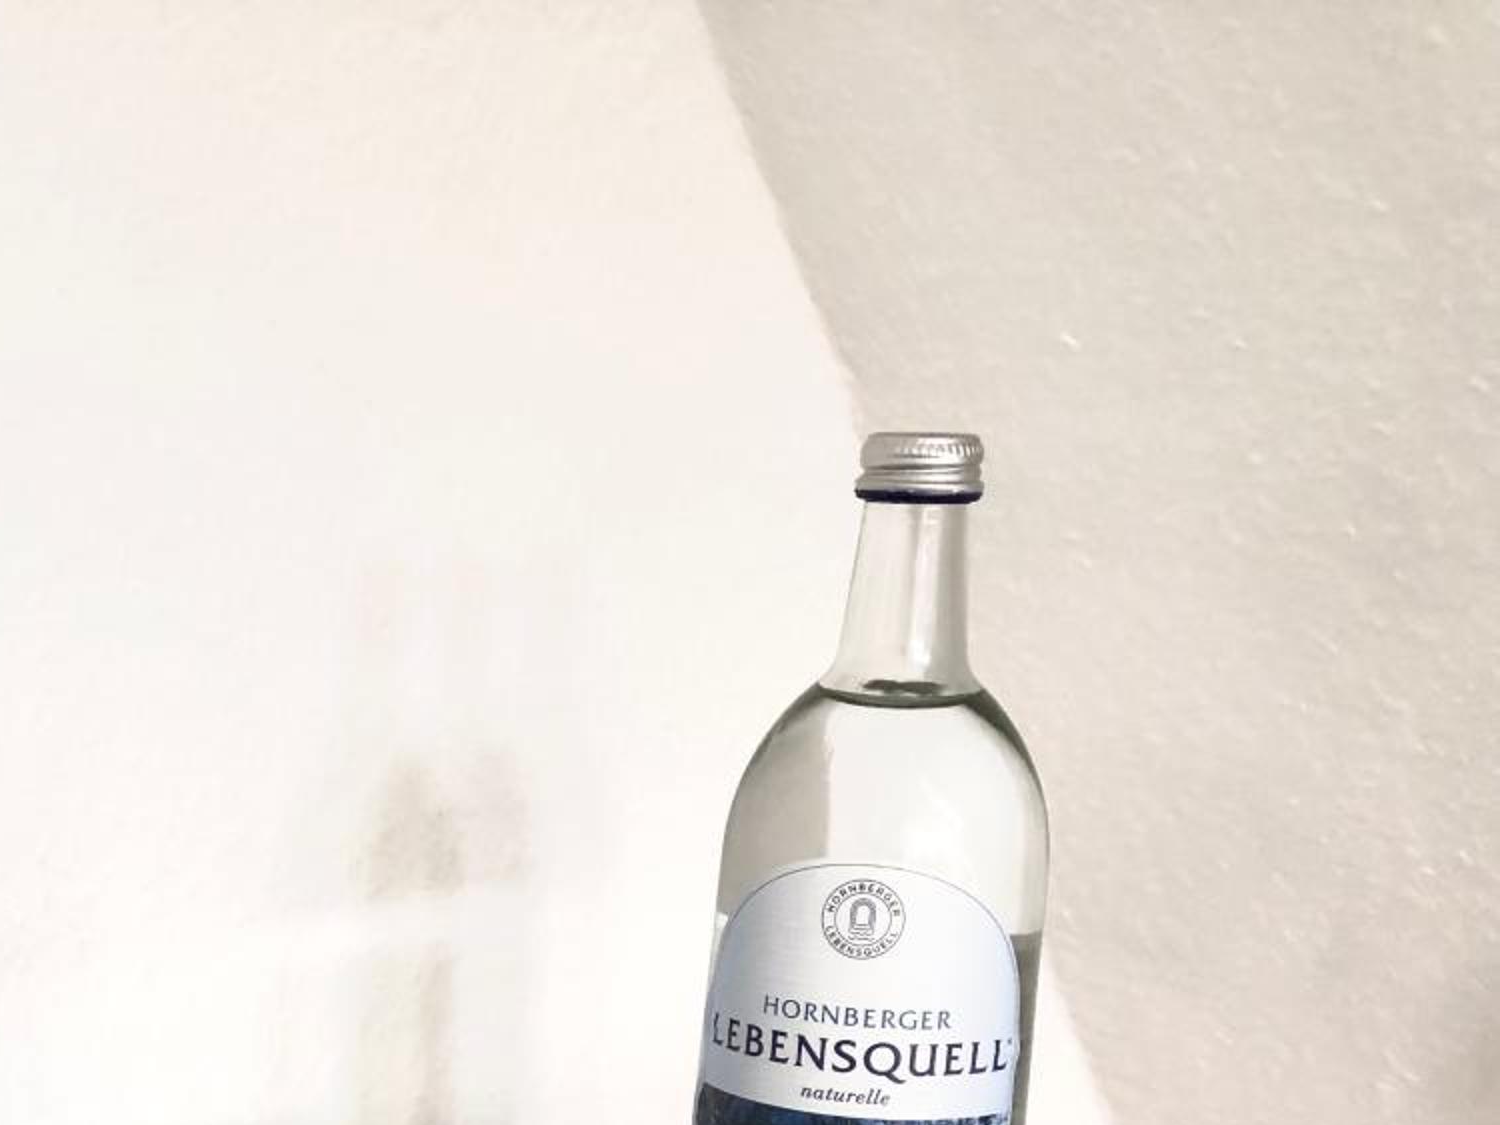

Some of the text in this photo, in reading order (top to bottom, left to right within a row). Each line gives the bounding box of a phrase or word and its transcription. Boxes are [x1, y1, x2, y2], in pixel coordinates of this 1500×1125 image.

[827, 882, 902, 917] HORNBERGER
[825, 925, 900, 958] LEBENSQUELL
[763, 994, 952, 1032] HORNBERGER
[711, 1012, 1009, 1084] LEBENSQUELL
[800, 1086, 891, 1106] naturelle
